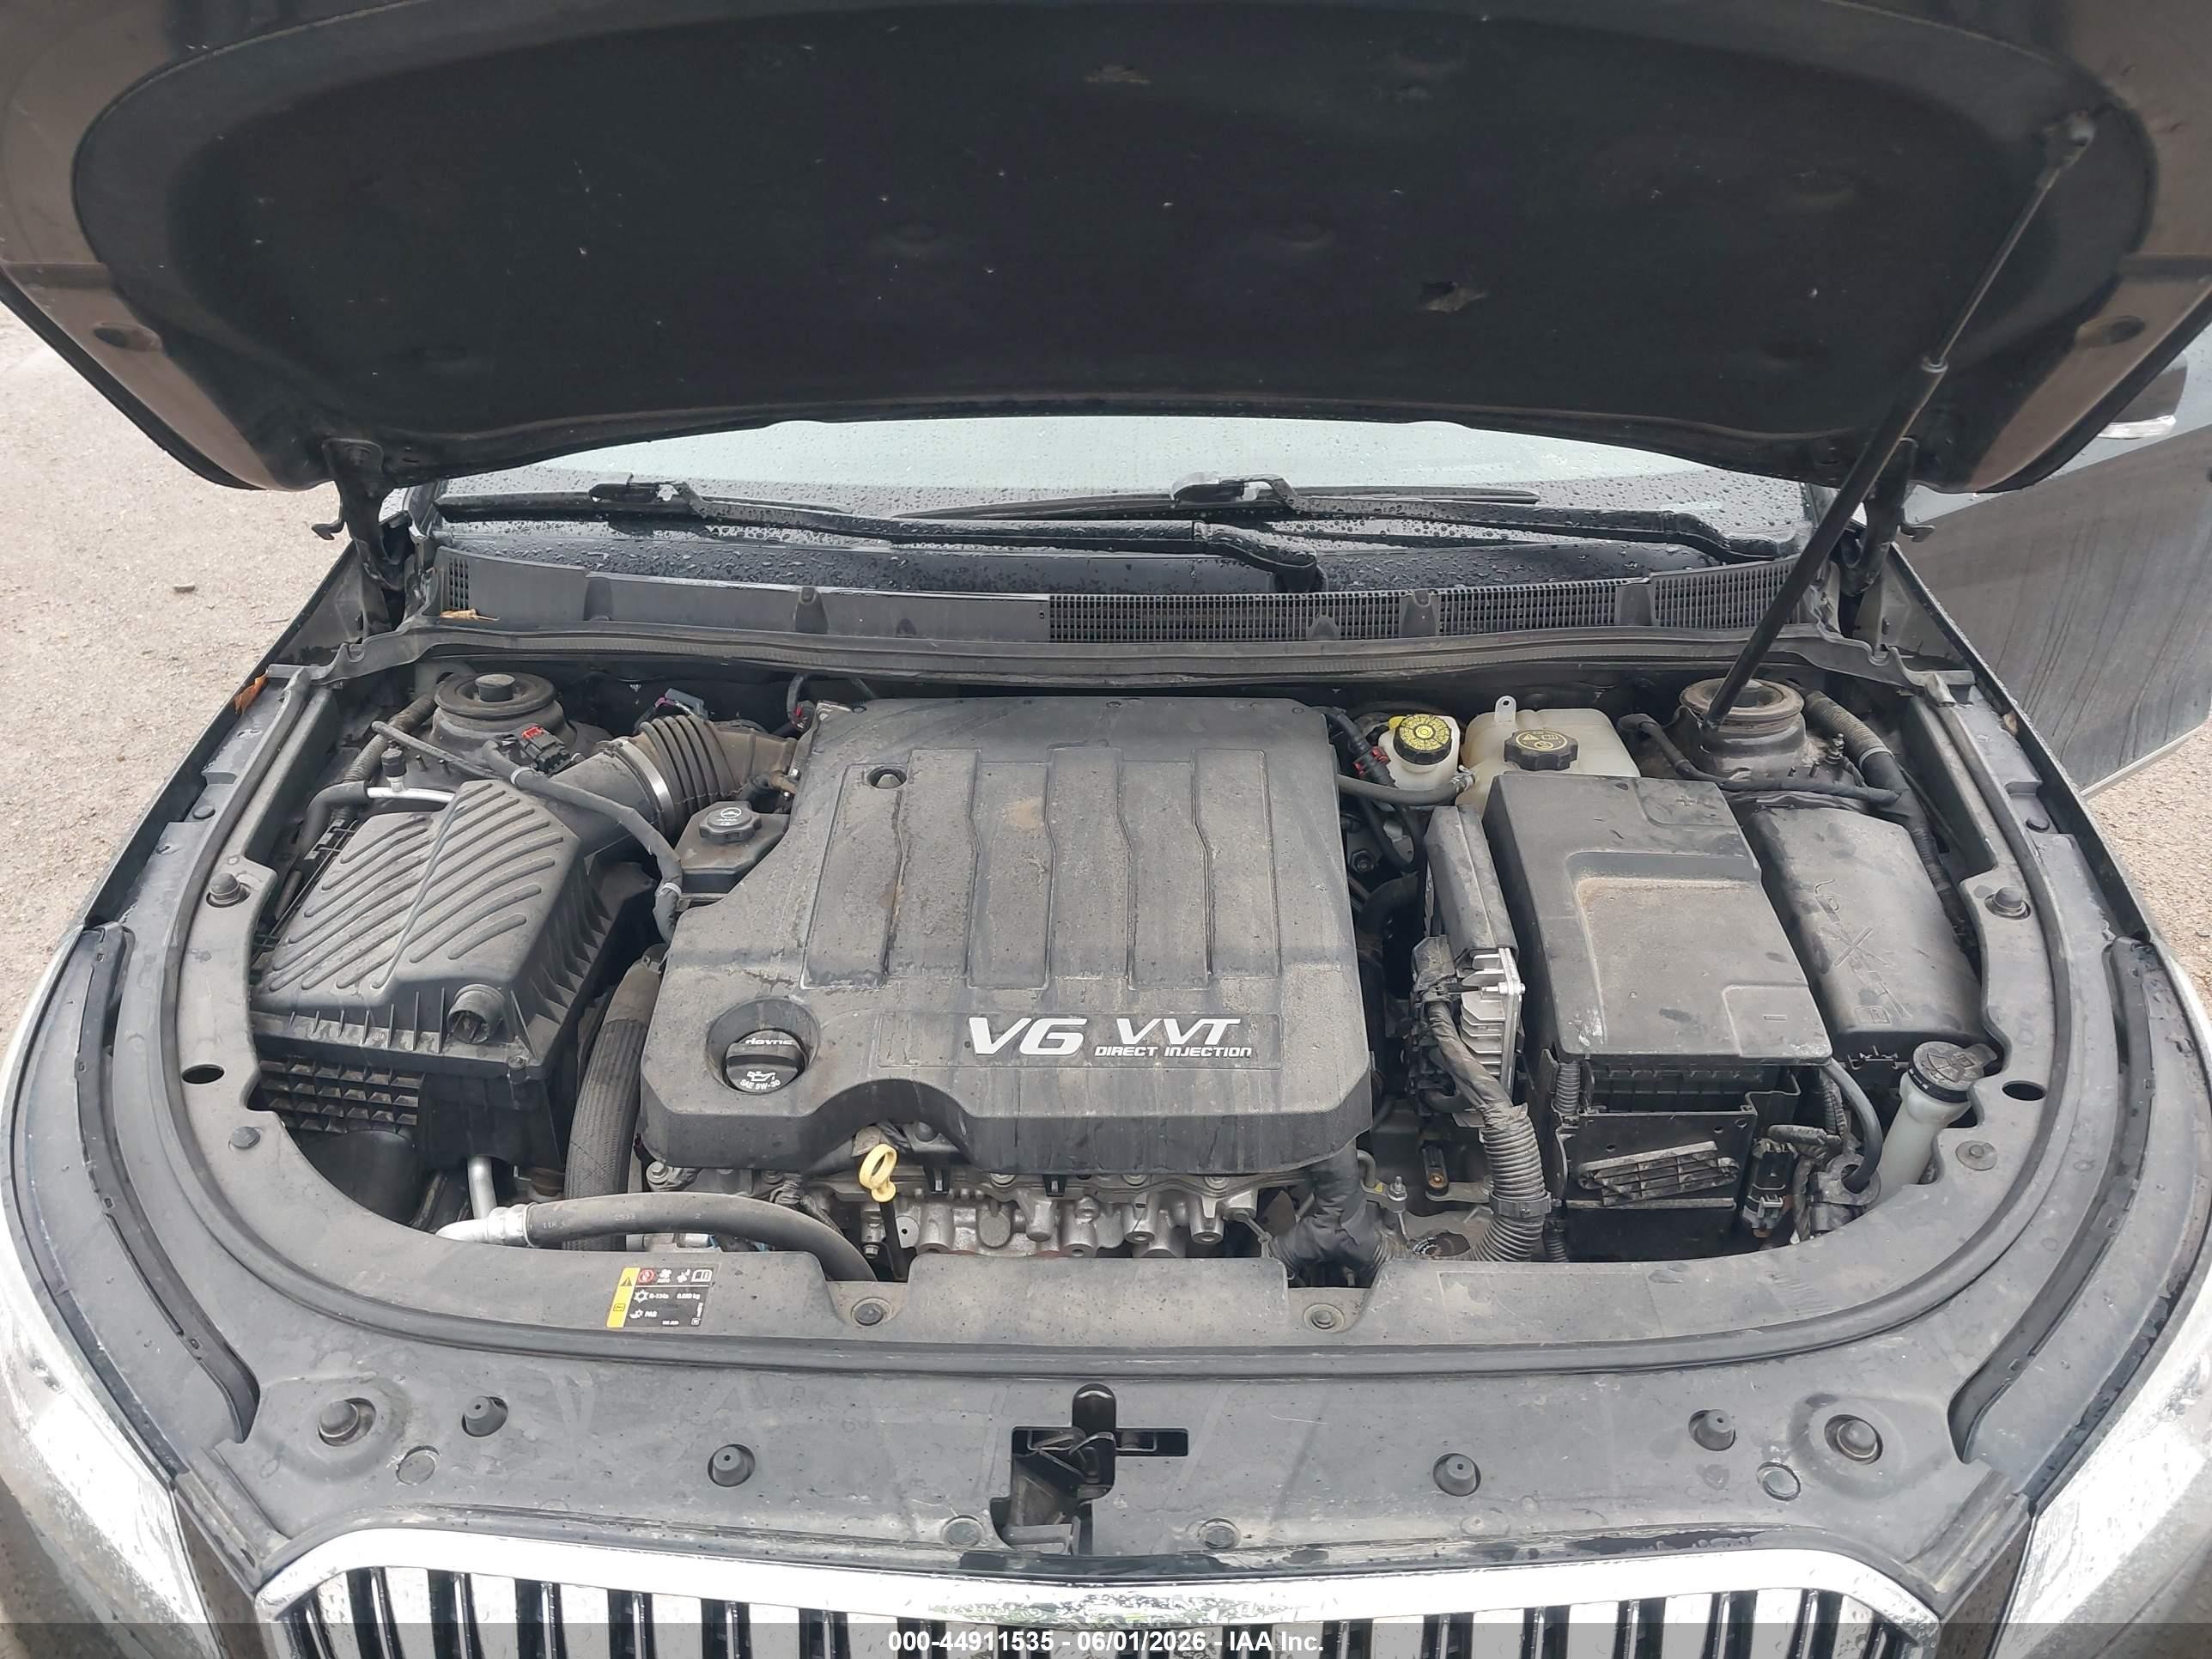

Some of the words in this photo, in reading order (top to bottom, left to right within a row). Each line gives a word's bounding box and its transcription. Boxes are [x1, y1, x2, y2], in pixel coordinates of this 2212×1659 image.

[969, 1017, 1088, 1055] V6
[1116, 1018, 1242, 1045] VVT
[1094, 1046, 1158, 1057] DIRECT
[1164, 1047, 1252, 1057] INJECTION
[739, 1079, 755, 1090] SAE
[755, 1079, 781, 1090] 5W-30
